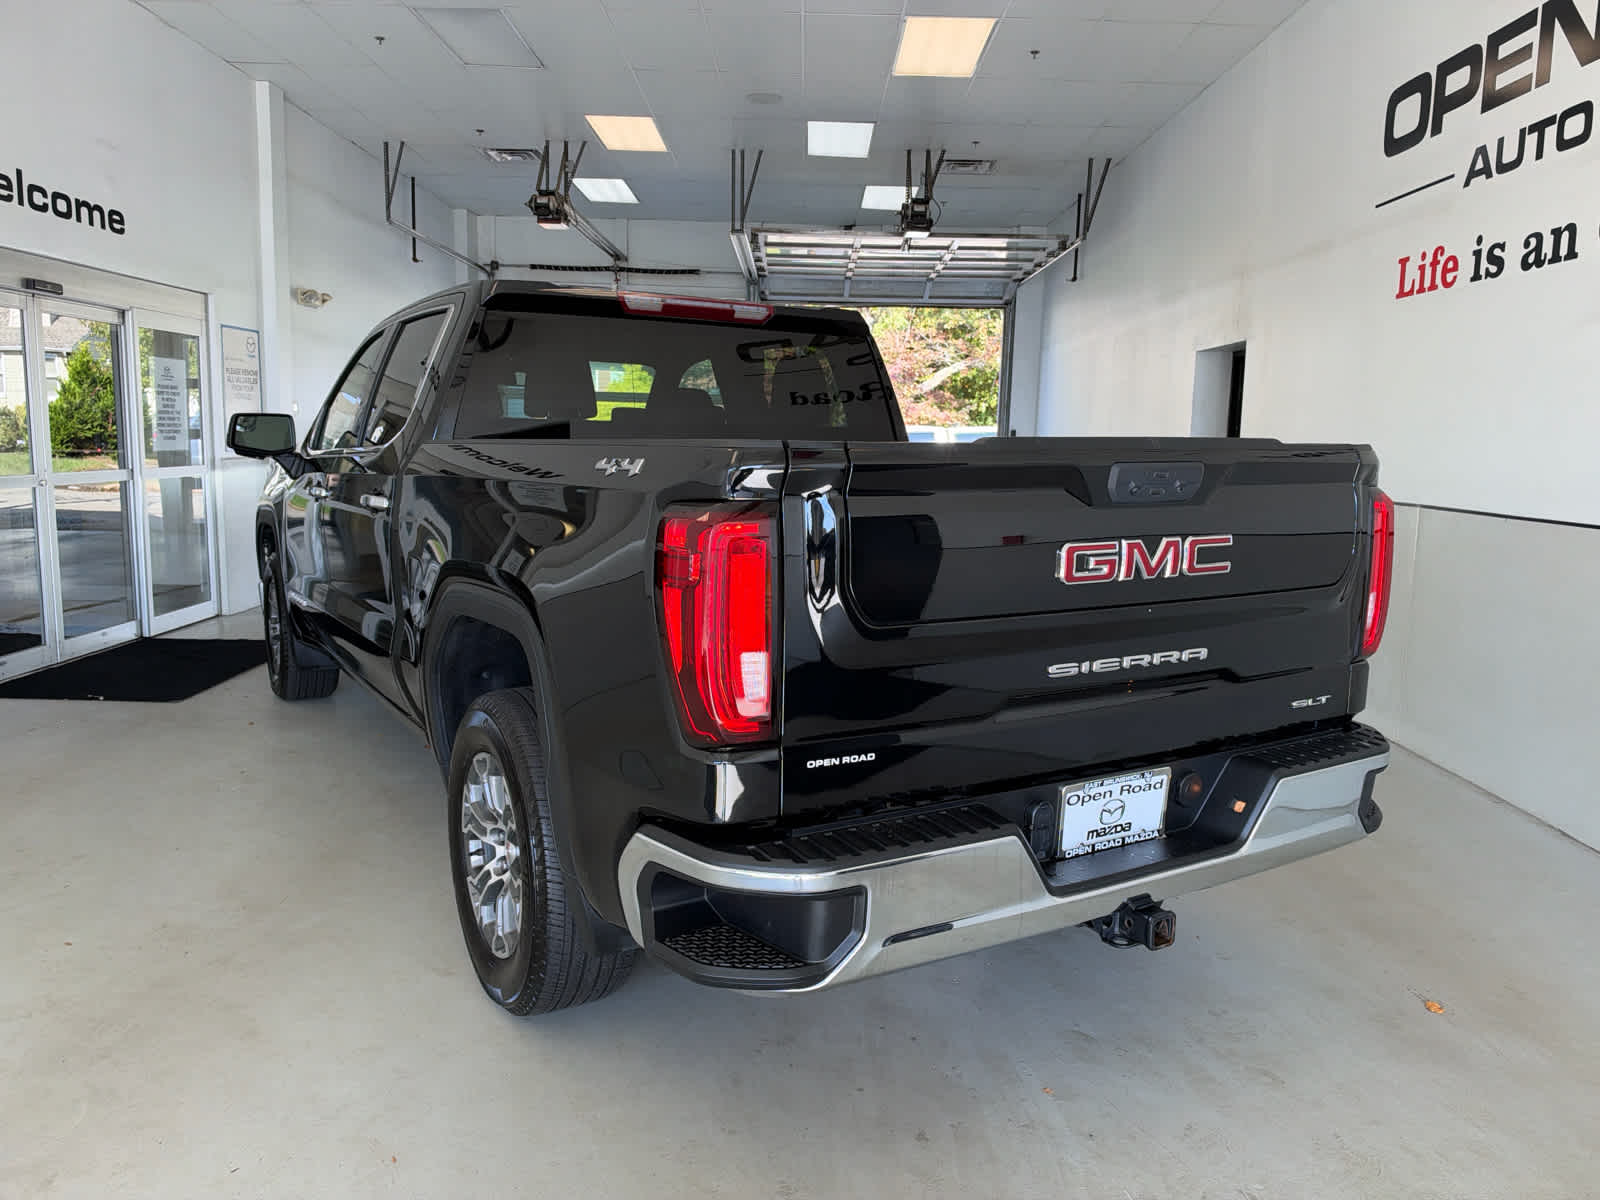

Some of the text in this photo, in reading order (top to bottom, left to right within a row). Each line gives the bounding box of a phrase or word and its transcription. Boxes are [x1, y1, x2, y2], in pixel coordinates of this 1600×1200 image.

[1384, 0, 1600, 158] OPEN
[1463, 99, 1594, 189] AUTO
[1395, 221, 1579, 300] Life is an
[1055, 534, 1233, 585] GMC
[1047, 647, 1209, 679] SIERRA
[1290, 694, 1332, 709] SLT
[806, 752, 876, 769] OPEN ROAD
[1066, 781, 1164, 807] Open Road
[1065, 830, 1160, 858] OPEN ROAD MAZDA
